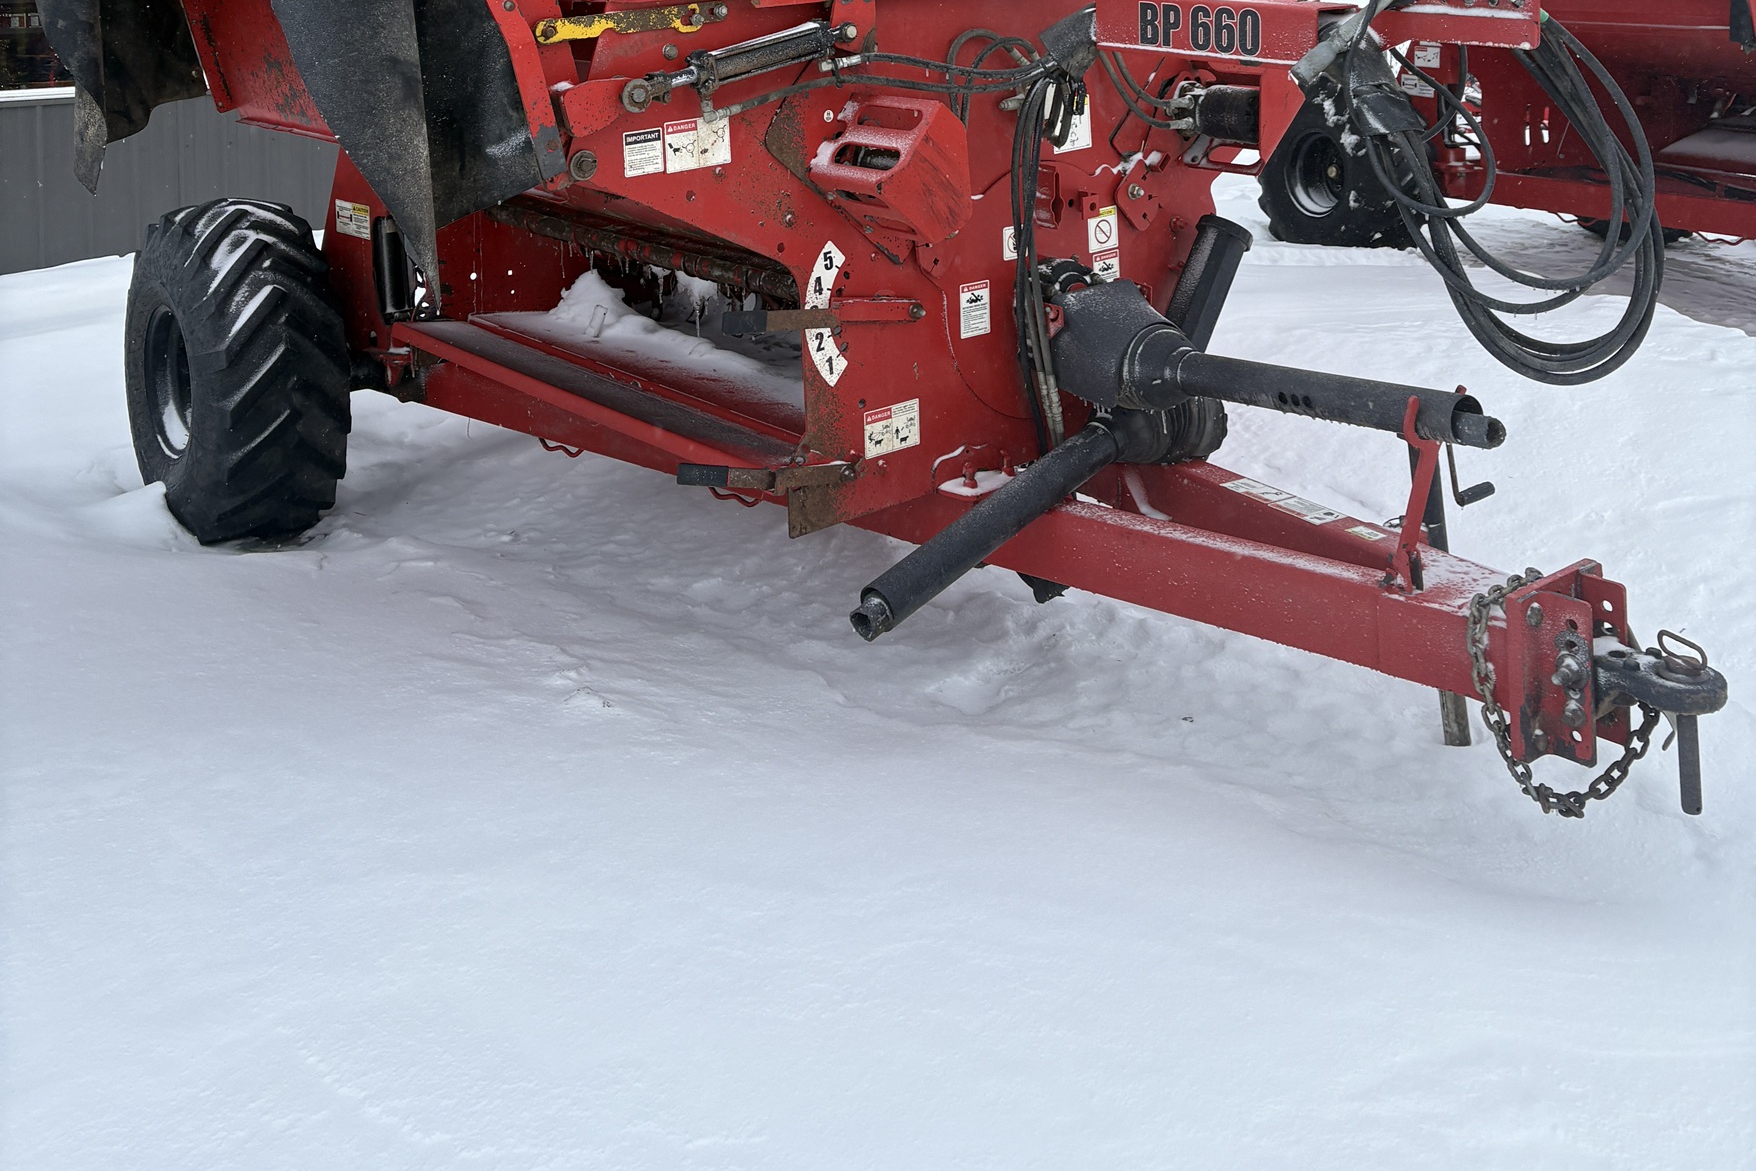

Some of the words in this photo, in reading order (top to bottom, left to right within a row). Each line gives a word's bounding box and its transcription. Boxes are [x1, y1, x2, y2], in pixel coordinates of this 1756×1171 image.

[1138, 1, 1181, 48] BP
[1190, 4, 1261, 56] 660
[673, 123, 695, 131] DANGER
[626, 132, 659, 143] IMPORTANT
[823, 251, 834, 270] 5
[814, 276, 823, 296] 4
[815, 332, 825, 352] 2
[826, 356, 834, 375] 1
